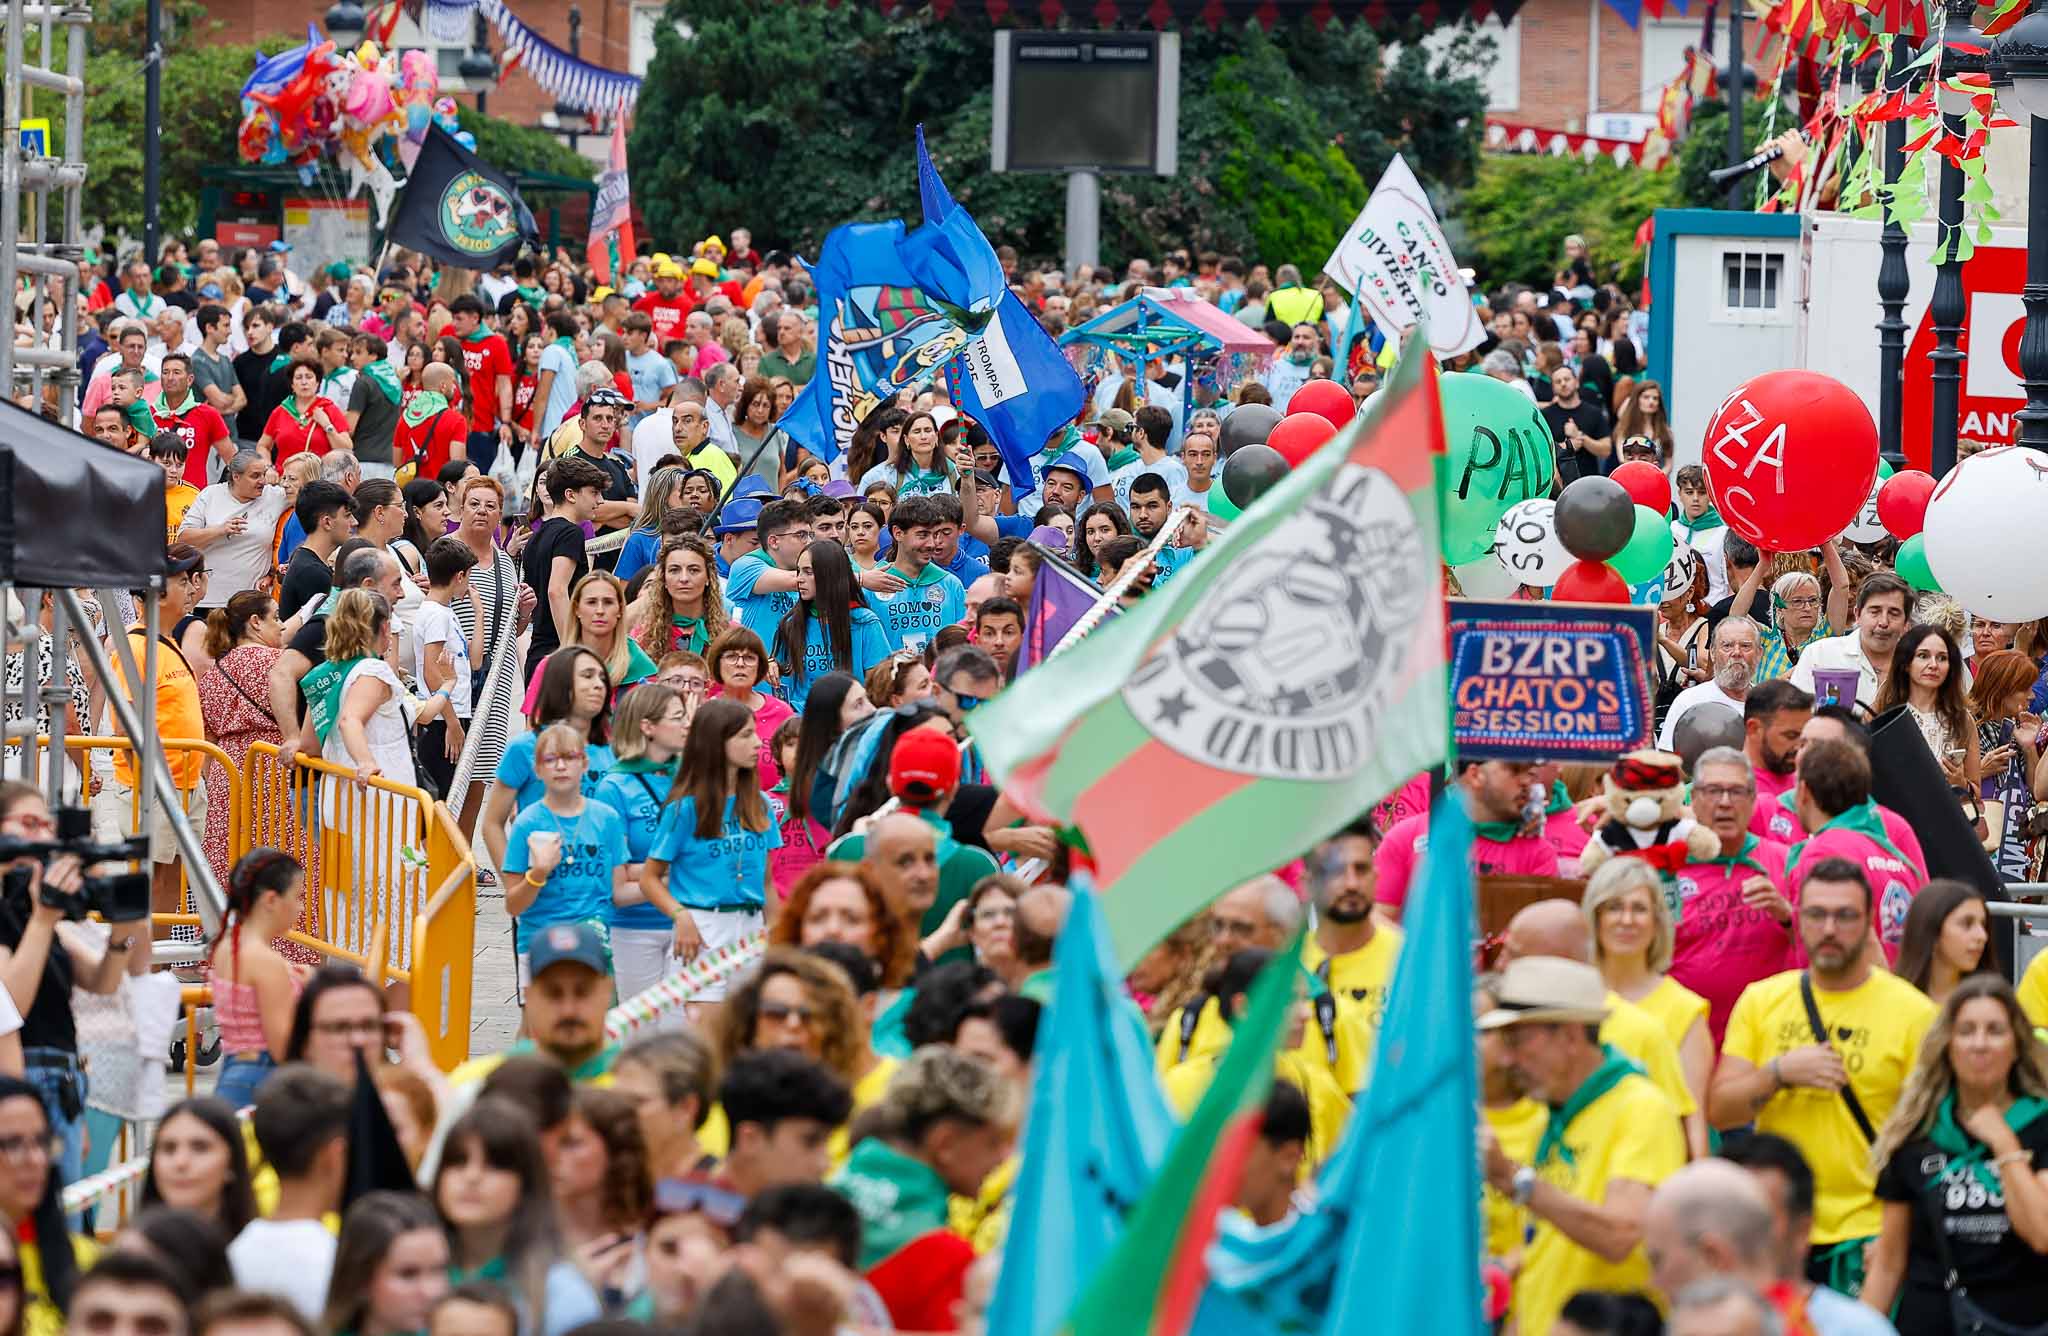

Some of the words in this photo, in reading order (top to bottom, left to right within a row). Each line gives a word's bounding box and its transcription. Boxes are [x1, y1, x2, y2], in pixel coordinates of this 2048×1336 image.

[1396, 221, 1447, 297] GANZO
[1399, 254, 1418, 279] SE
[976, 336, 1003, 399] TROMPAS
[890, 615, 942, 630] 39300
[1480, 636, 1606, 677] BZRP
[1457, 675, 1621, 714] CHATO'S
[1471, 708, 1597, 733] SESSION
